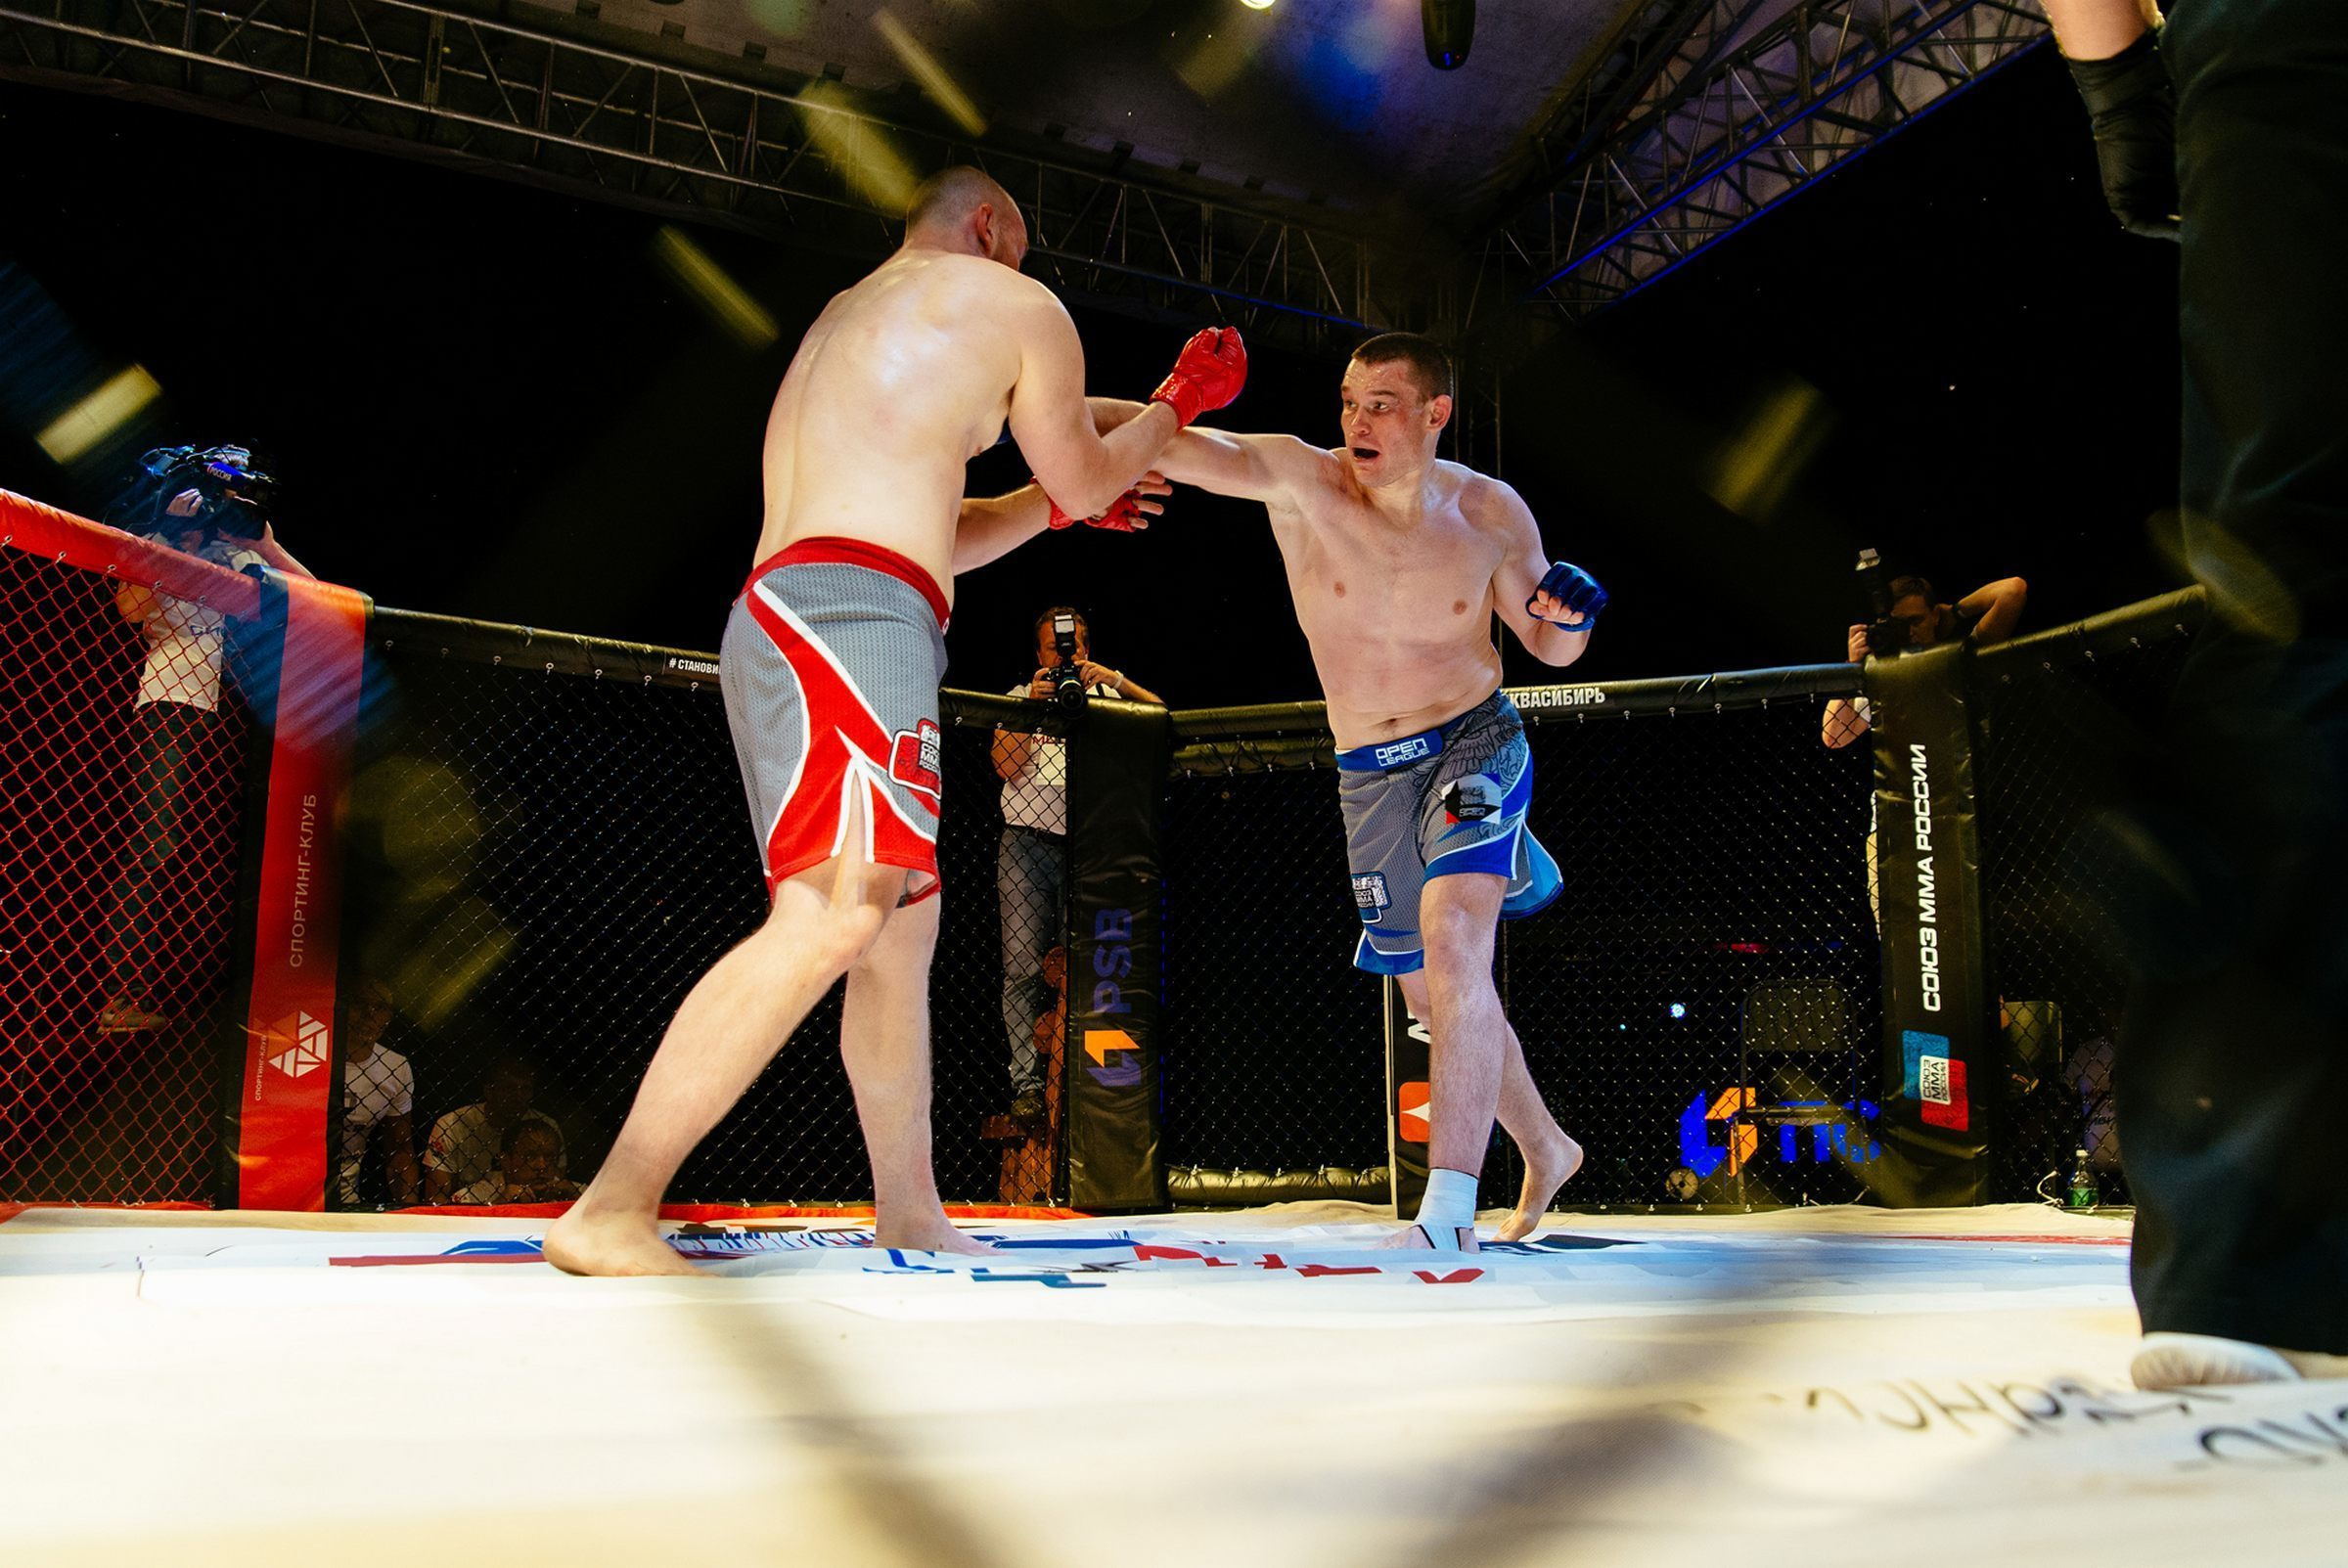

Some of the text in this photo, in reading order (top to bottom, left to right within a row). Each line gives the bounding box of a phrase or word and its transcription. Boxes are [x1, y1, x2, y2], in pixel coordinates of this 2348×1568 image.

[678, 659, 722, 675] СТАНОВИ
[1376, 738, 1427, 759] OPEN
[1378, 747, 1430, 767] LEAGUE
[290, 794, 317, 967] СПОРТИНГ-КЛУБ
[1910, 744, 1941, 1012] СОЮЗ ММА РОССИИ
[1093, 908, 1133, 1013] PSB
[1922, 1059, 1931, 1098] СОЮЗ
[1931, 1061, 1942, 1099] ММА
